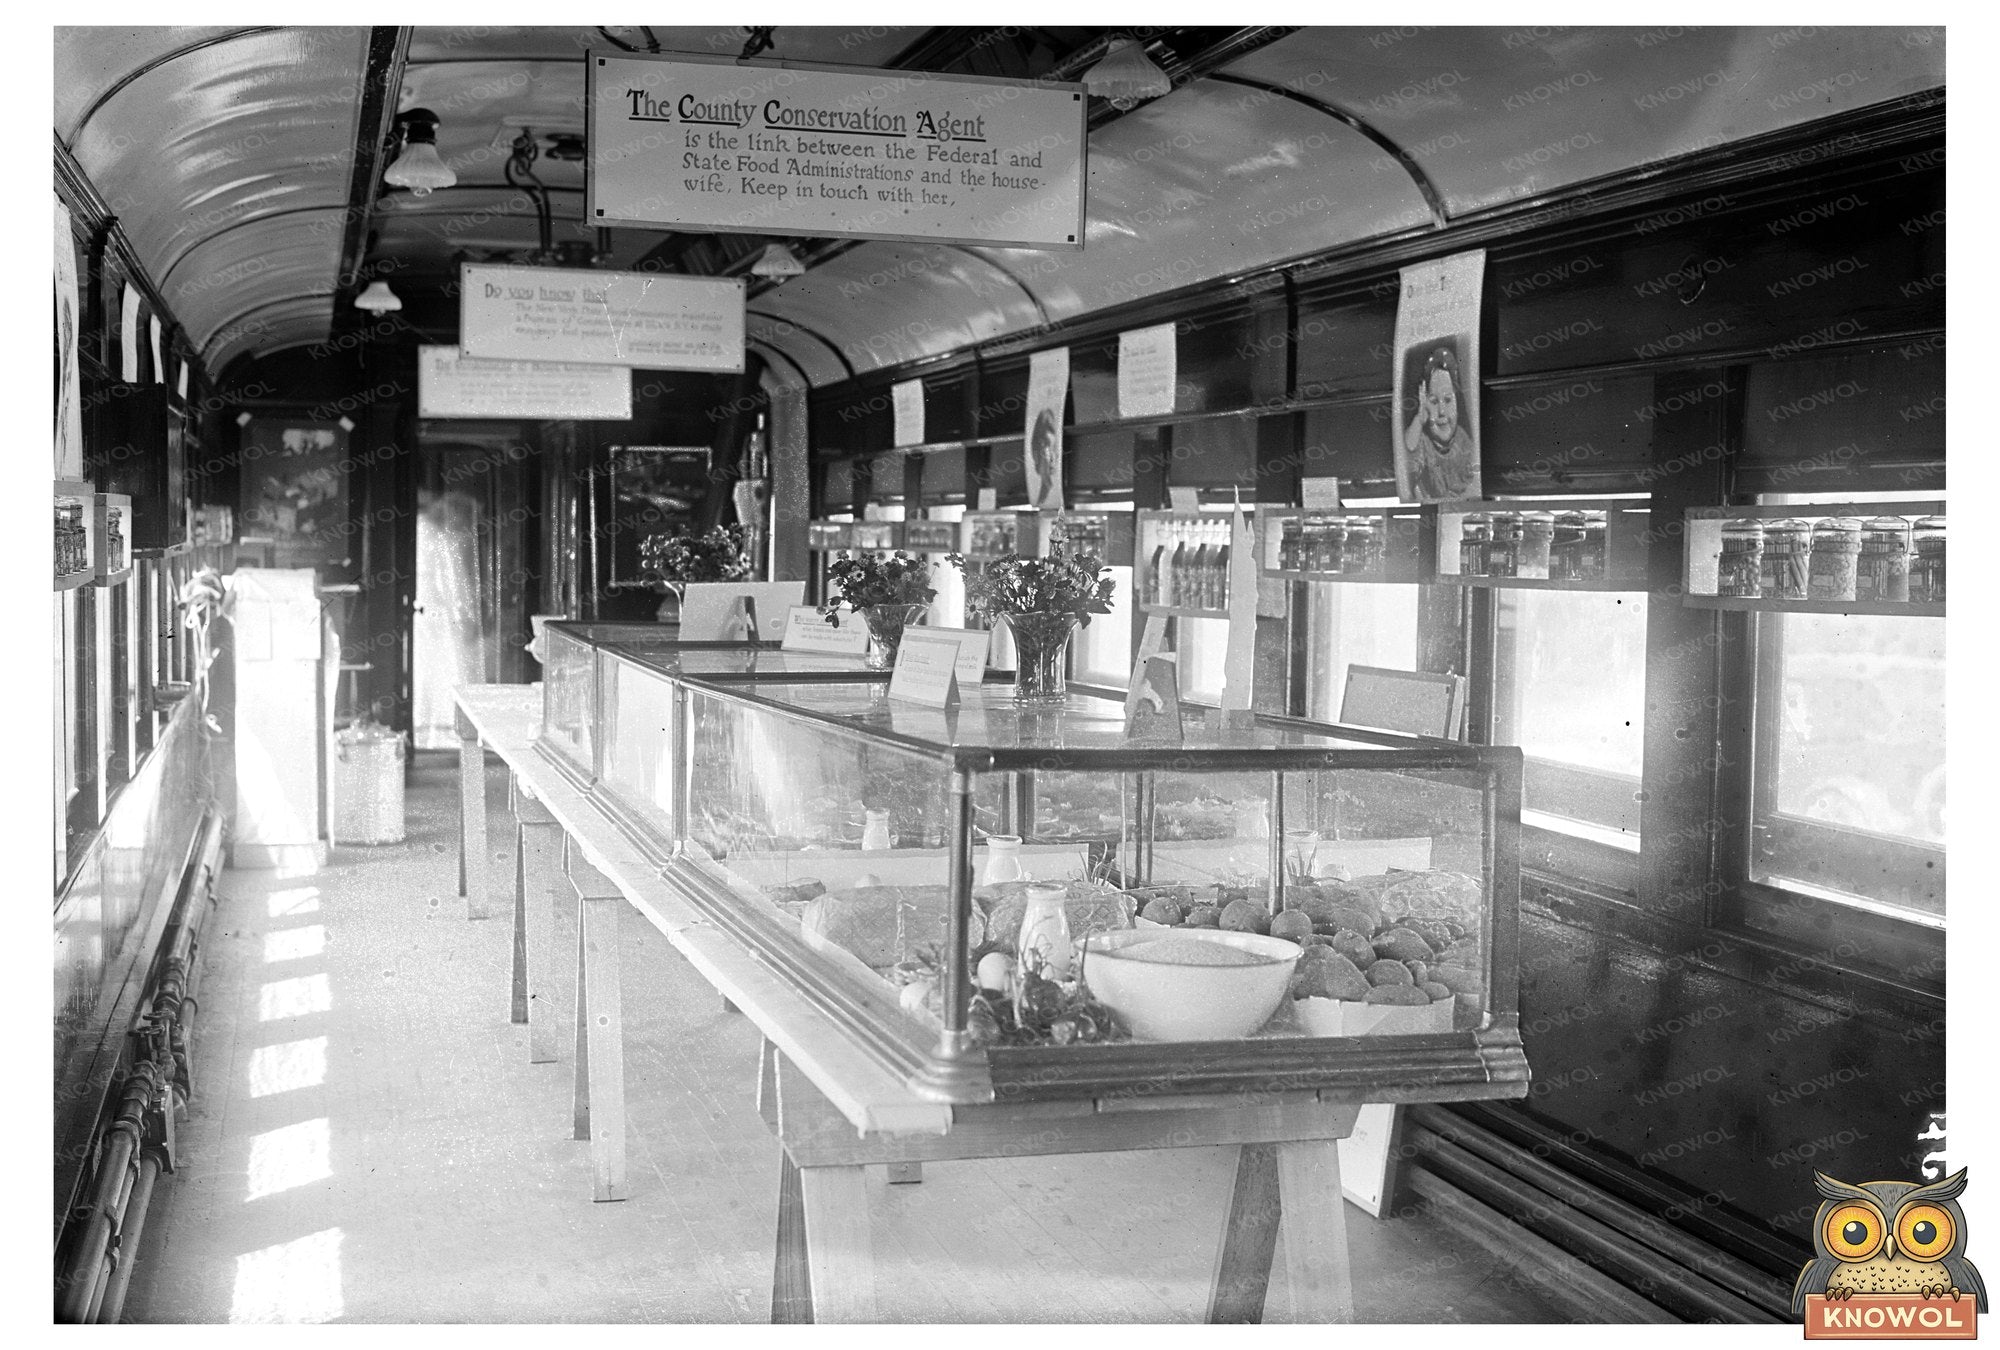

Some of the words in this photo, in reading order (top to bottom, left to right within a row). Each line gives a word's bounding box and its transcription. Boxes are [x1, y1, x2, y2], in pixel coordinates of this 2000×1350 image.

[626, 88, 672, 118] The
[678, 94, 757, 129] County
[763, 99, 907, 132] Conservation
[916, 110, 985, 142] Agent
[685, 129, 701, 148] is
[708, 131, 738, 150] the
[748, 133, 791, 152] link
[797, 136, 875, 158] between
[885, 143, 918, 160] the
[927, 144, 998, 165] Federal
[1010, 151, 1043, 168] and
[682, 152, 732, 171] State
[736, 155, 780, 174] Food
[787, 157, 914, 182] Administrations
[920, 168, 952, 184] and
[960, 168, 986, 186] the
[741, 177, 788, 200] Keep
[796, 180, 814, 198] in
[820, 183, 868, 201] touch
[877, 186, 914, 203] with
[485, 282, 502, 299] Do
[508, 287, 533, 300] you
